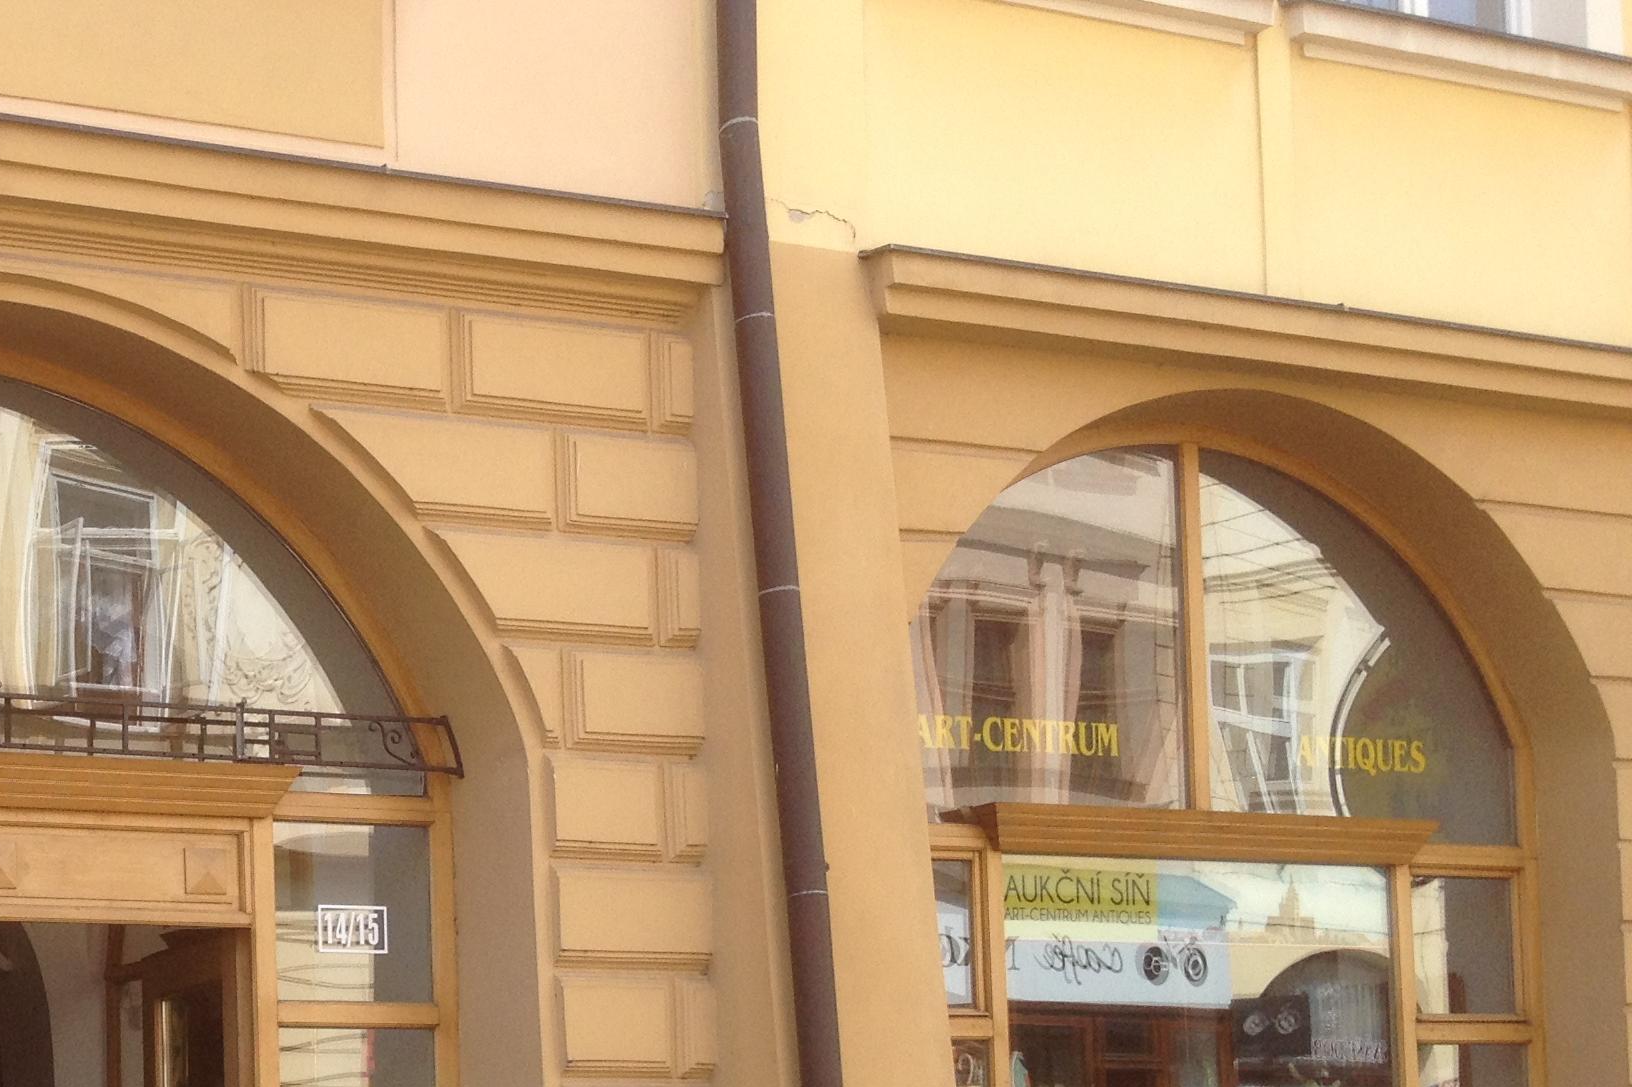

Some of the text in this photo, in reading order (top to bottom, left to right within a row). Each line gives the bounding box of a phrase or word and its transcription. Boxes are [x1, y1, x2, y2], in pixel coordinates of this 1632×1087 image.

[918, 714, 1119, 757] ART-CENTRUM
[1297, 735, 1427, 776] ANTIQUES
[1004, 868, 1150, 905] AUKČNÍ SÍŇ
[324, 911, 379, 947] 14/15
[1004, 907, 1152, 925] ART-CENTRUM ANTIQUES
